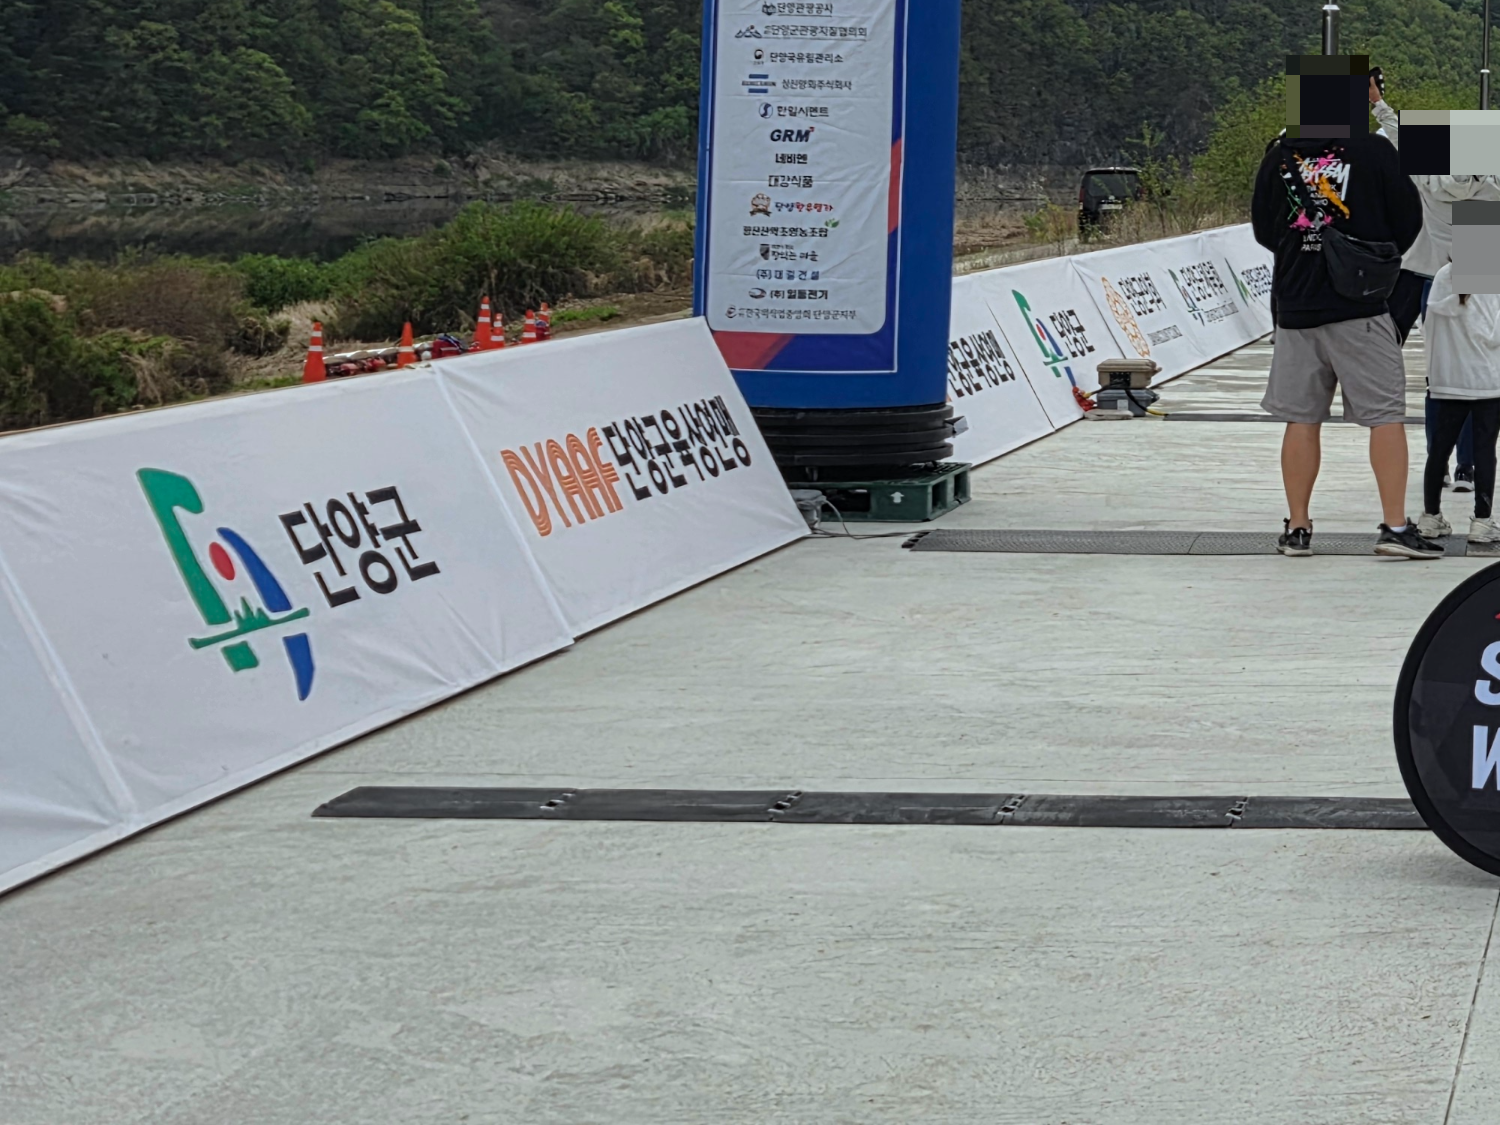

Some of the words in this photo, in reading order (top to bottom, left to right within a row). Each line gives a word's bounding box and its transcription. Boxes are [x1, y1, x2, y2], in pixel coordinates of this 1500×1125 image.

[777, 2, 833, 14] 단양관광공사
[770, 52, 844, 63] 단양국유림관리소
[777, 106, 829, 117] 한일시멘트
[770, 128, 811, 142] GRM
[775, 153, 808, 164] 네비엔
[1049, 309, 1095, 359] 단양군
[500, 426, 624, 537] DYAAF
[601, 395, 753, 501] 단양군육상연맹
[279, 485, 441, 609] 단양군
